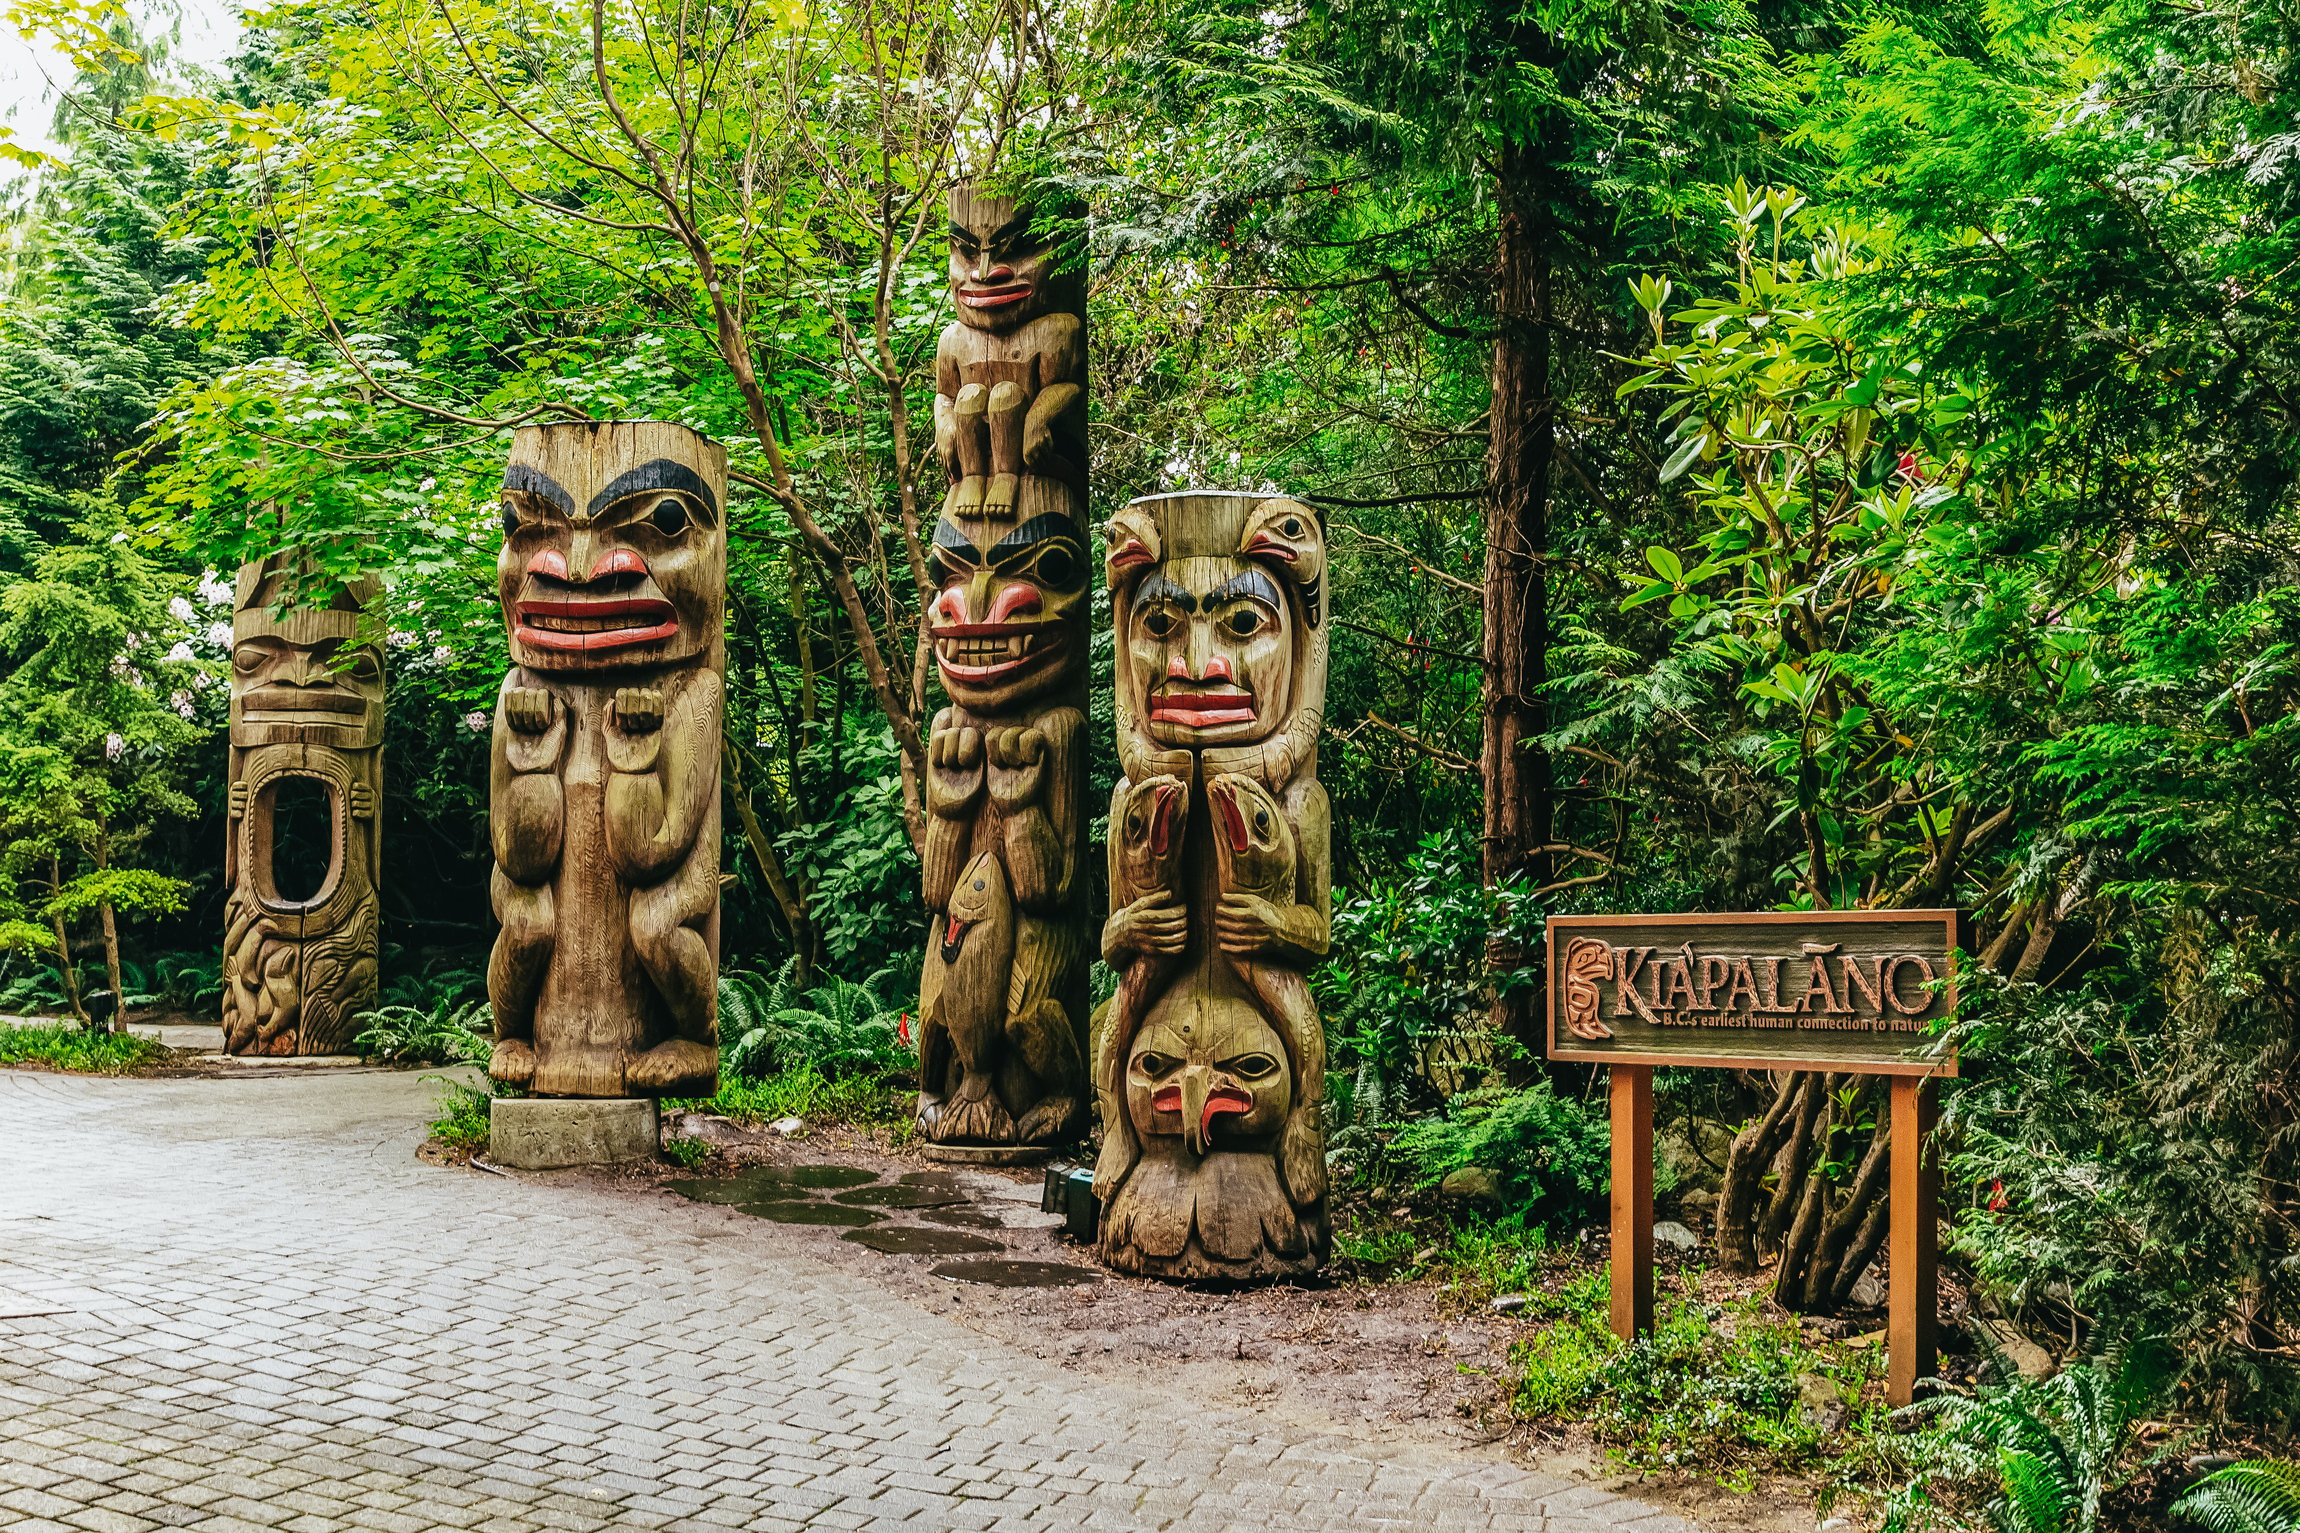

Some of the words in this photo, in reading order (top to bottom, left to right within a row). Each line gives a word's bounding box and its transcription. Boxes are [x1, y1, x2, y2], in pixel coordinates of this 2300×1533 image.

[1700, 1012, 1748, 1028] earliest
[1749, 1013, 1794, 1029] human
[1796, 1016, 1870, 1031] connection
[1872, 1016, 1888, 1031] to
[1890, 1017, 1930, 1032] natur
